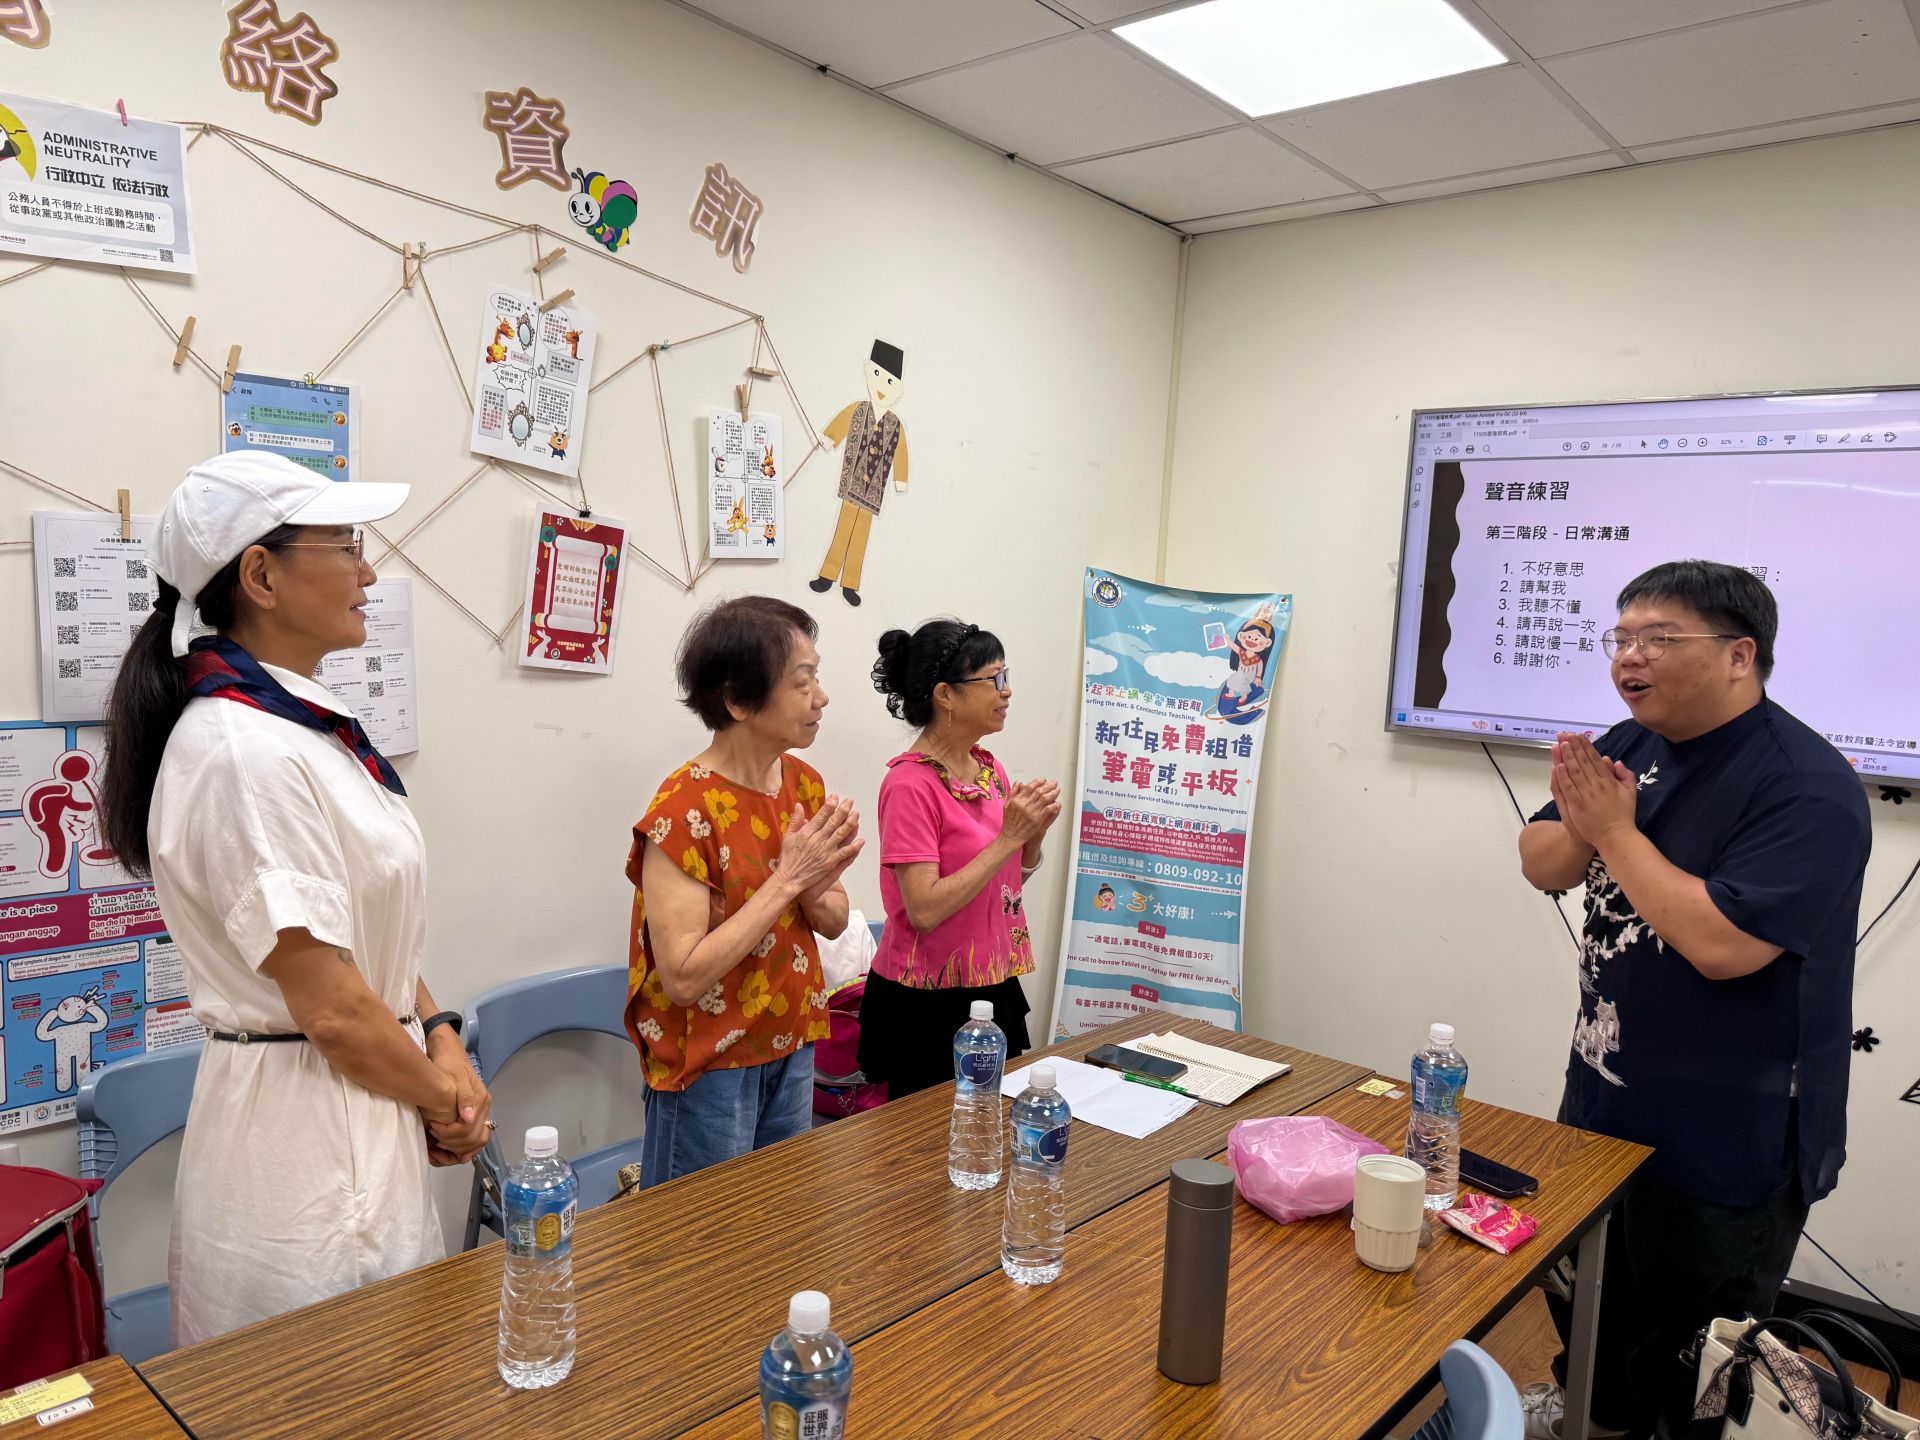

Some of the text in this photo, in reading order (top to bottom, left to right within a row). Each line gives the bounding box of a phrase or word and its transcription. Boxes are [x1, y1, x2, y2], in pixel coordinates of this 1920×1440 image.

[229, 0, 760, 267] 絡 資 訊
[43, 132, 158, 161] ADMINISTRATIVE
[44, 144, 131, 169] NEUTRALITY
[46, 166, 169, 198] 行政中立 依法行政
[9, 204, 155, 233] 從事政黨或其他政治團體之活動
[1485, 481, 1570, 501] 聲音練習
[1486, 525, 1547, 540] 第三階段
[1565, 525, 1630, 541] 日常溝通
[1503, 563, 1513, 574] 1.
[1521, 561, 1584, 577] 不好意思
[1500, 580, 1567, 595] 2. 請幫我
[1498, 598, 1582, 614] 3. 我聽不懂
[1497, 616, 1596, 633] 4. 請再說一次
[1495, 635, 1593, 652] 5. 請說慢一點
[1493, 652, 1571, 668] 6. 謝謝你。
[1086, 681, 1202, 712] 起來上網 學習無距離
[1086, 698, 1104, 706] urfing
[1136, 704, 1167, 716] Contactless
[1168, 712, 1195, 721] Teaching
[1095, 717, 1253, 759] 新住民免費租借
[1820, 732, 1917, 749] 家庭教育暨法令宣導
[1102, 750, 1238, 796] 筆電或平板
[10, 908, 17, 916] is
[30, 904, 56, 916] piece
[1153, 902, 1194, 920] 大好康!
[106, 918, 118, 927] cho
[0, 928, 58, 941] angan anggap
[1098, 957, 1120, 966] borrow
[1121, 960, 1140, 969] Tablet
[1148, 966, 1167, 976] Laptop
[1169, 970, 1178, 978] for
[1179, 972, 1193, 980] FREE
[975, 1053, 996, 1063] Light
[0, 1111, 20, 1121] 管制署
[0, 1118, 20, 1126] CDC
[804, 1408, 828, 1423] 征服
[803, 1421, 828, 1436] 世界
